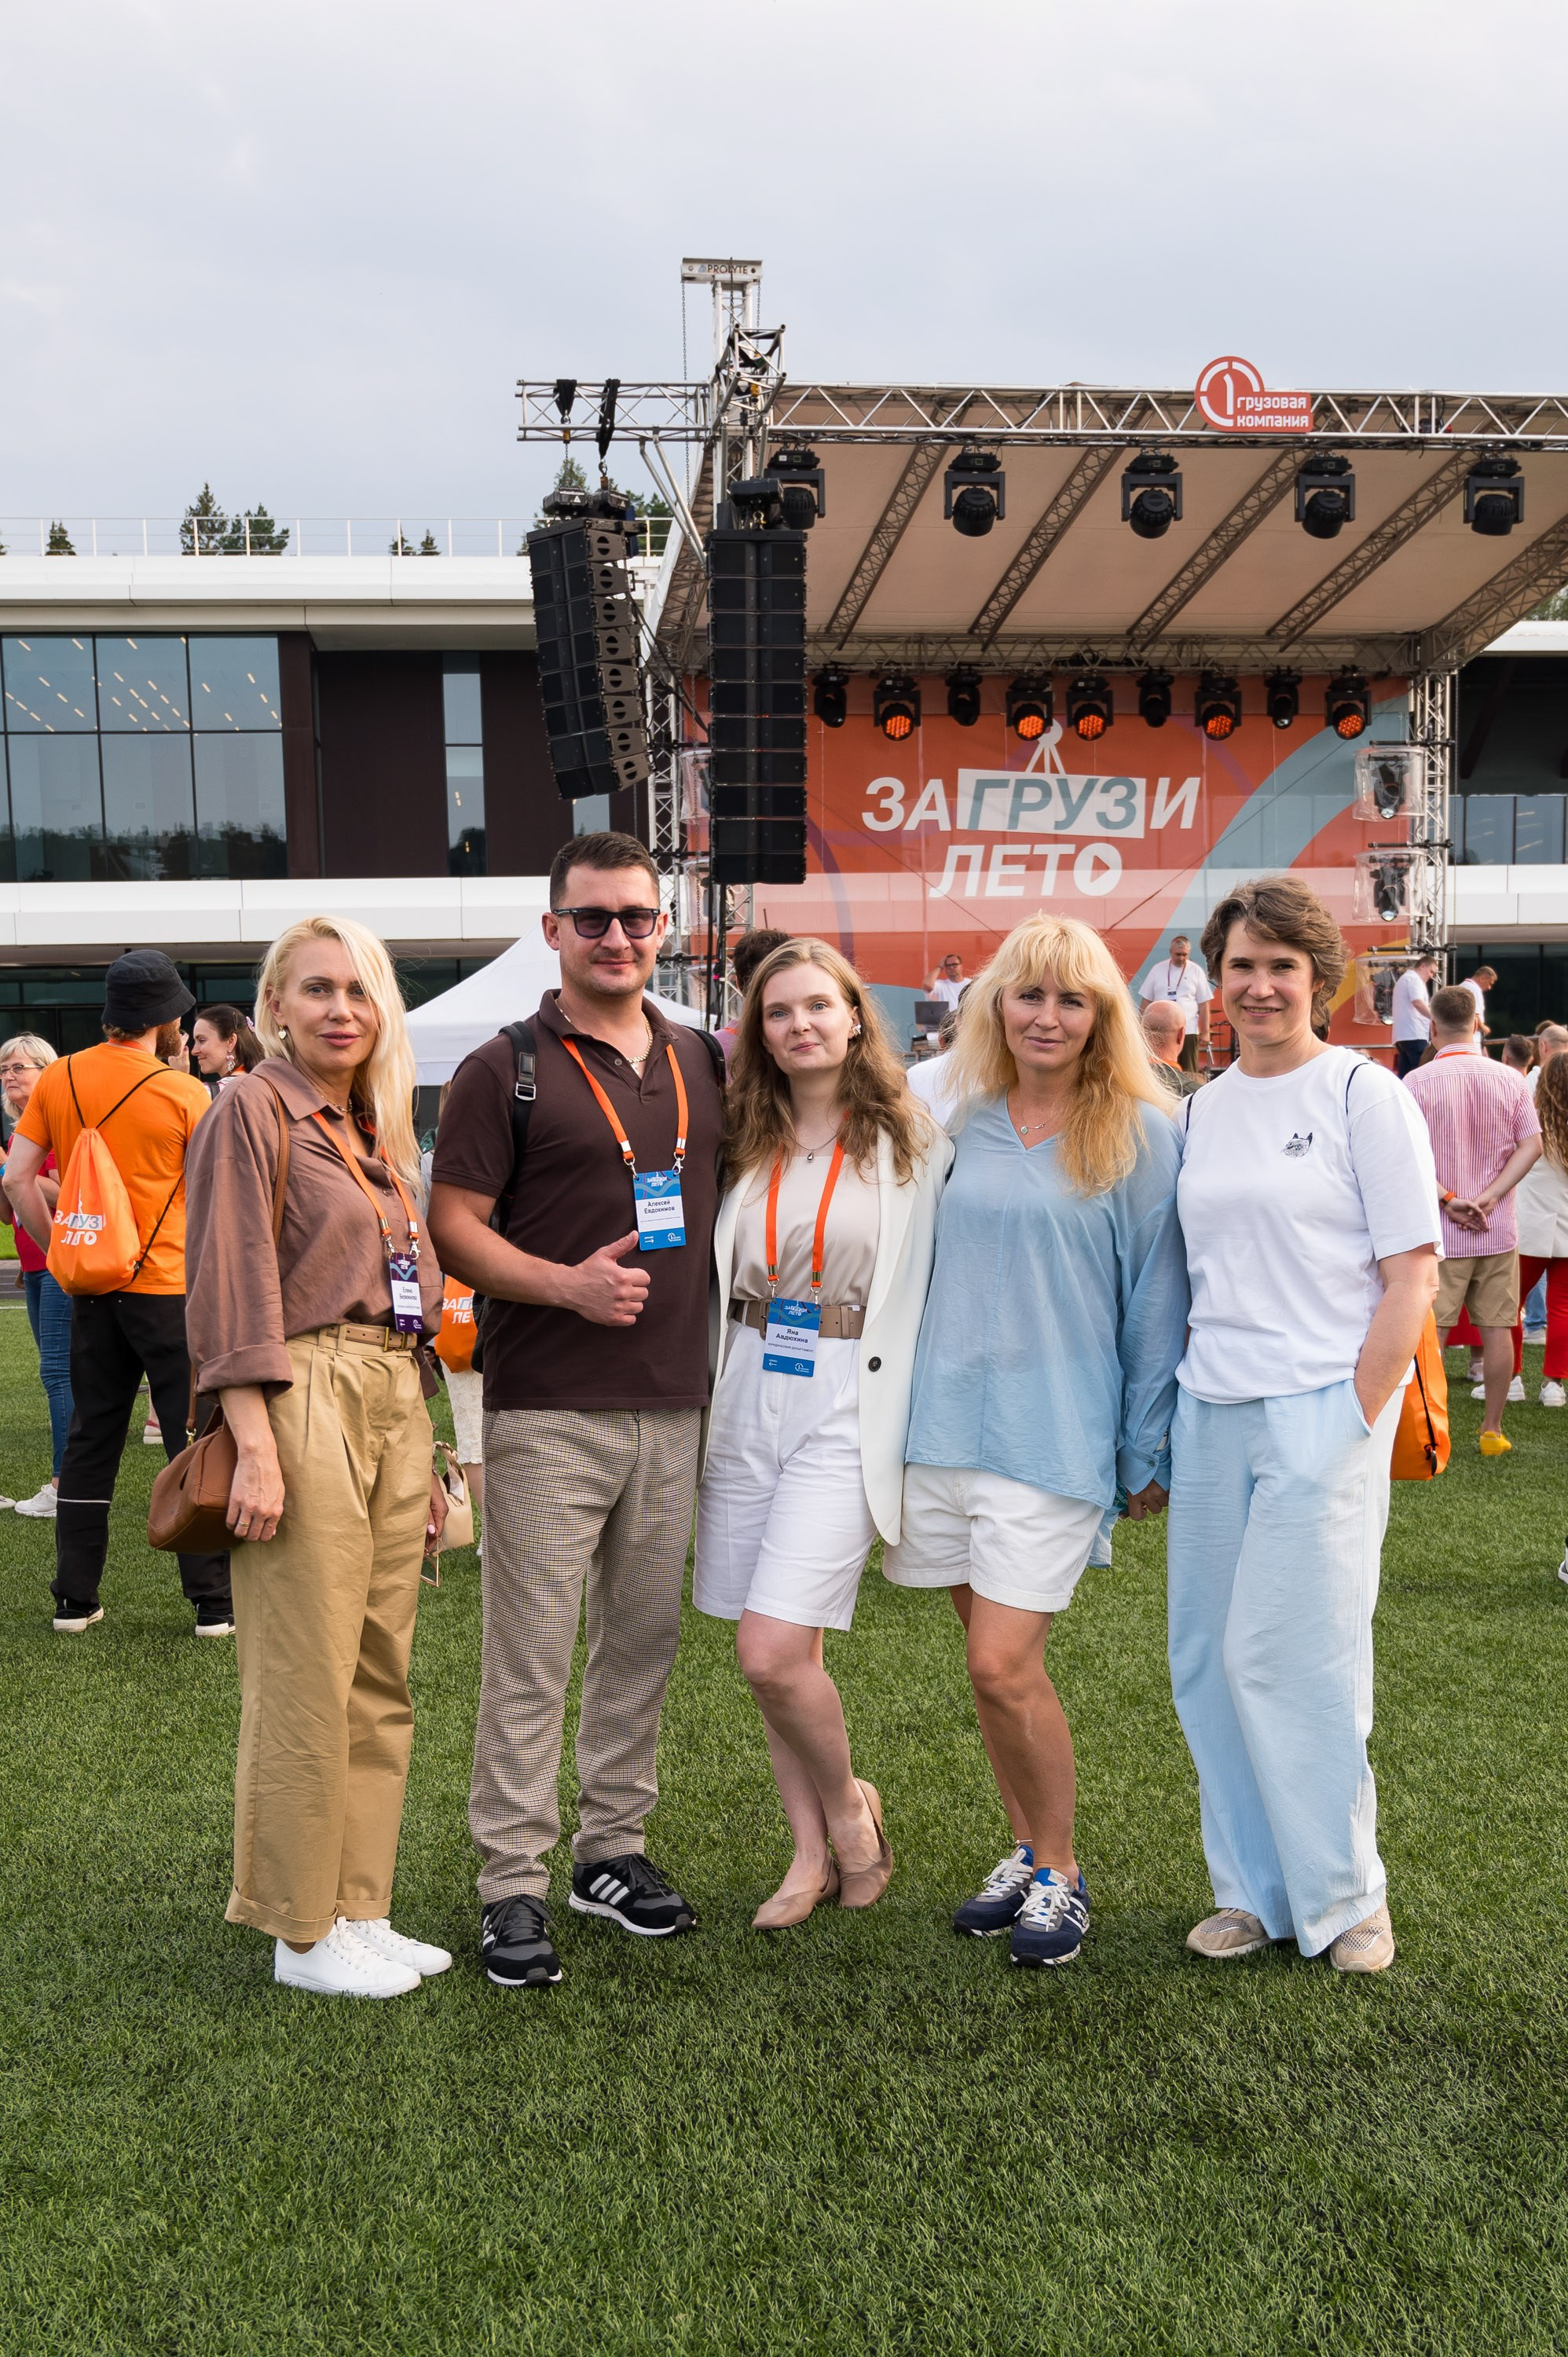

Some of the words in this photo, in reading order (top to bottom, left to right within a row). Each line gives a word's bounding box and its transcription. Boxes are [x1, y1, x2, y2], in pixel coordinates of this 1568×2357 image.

[707, 265, 748, 274] PROLYTE
[1237, 397, 1306, 411] грузовая
[1237, 415, 1310, 427] компания
[862, 776, 1201, 832] ЗАГРУЗИ
[929, 842, 1123, 898] ЛЕТО
[647, 1199, 671, 1208] Алексей
[775, 1332, 808, 1343] Авдюхина
